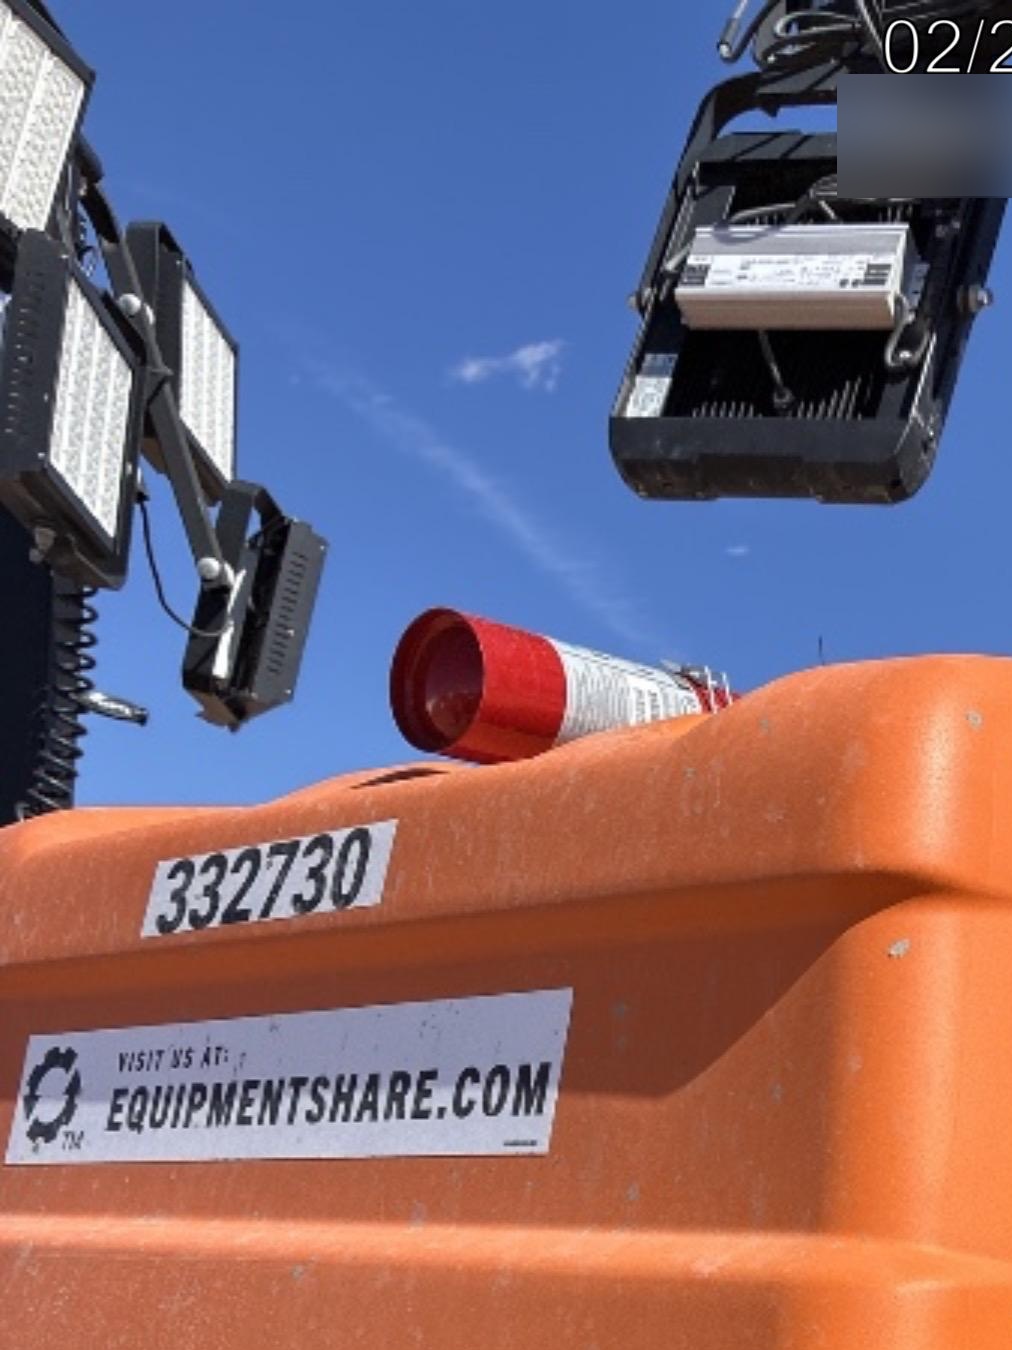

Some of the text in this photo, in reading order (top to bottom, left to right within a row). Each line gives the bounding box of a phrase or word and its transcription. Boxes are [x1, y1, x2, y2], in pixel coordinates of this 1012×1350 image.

[156, 828, 371, 933] 332730
[118, 1046, 229, 1072] VISIT US AT:
[105, 1062, 552, 1133] EQUIPMENTSHARE.COM
